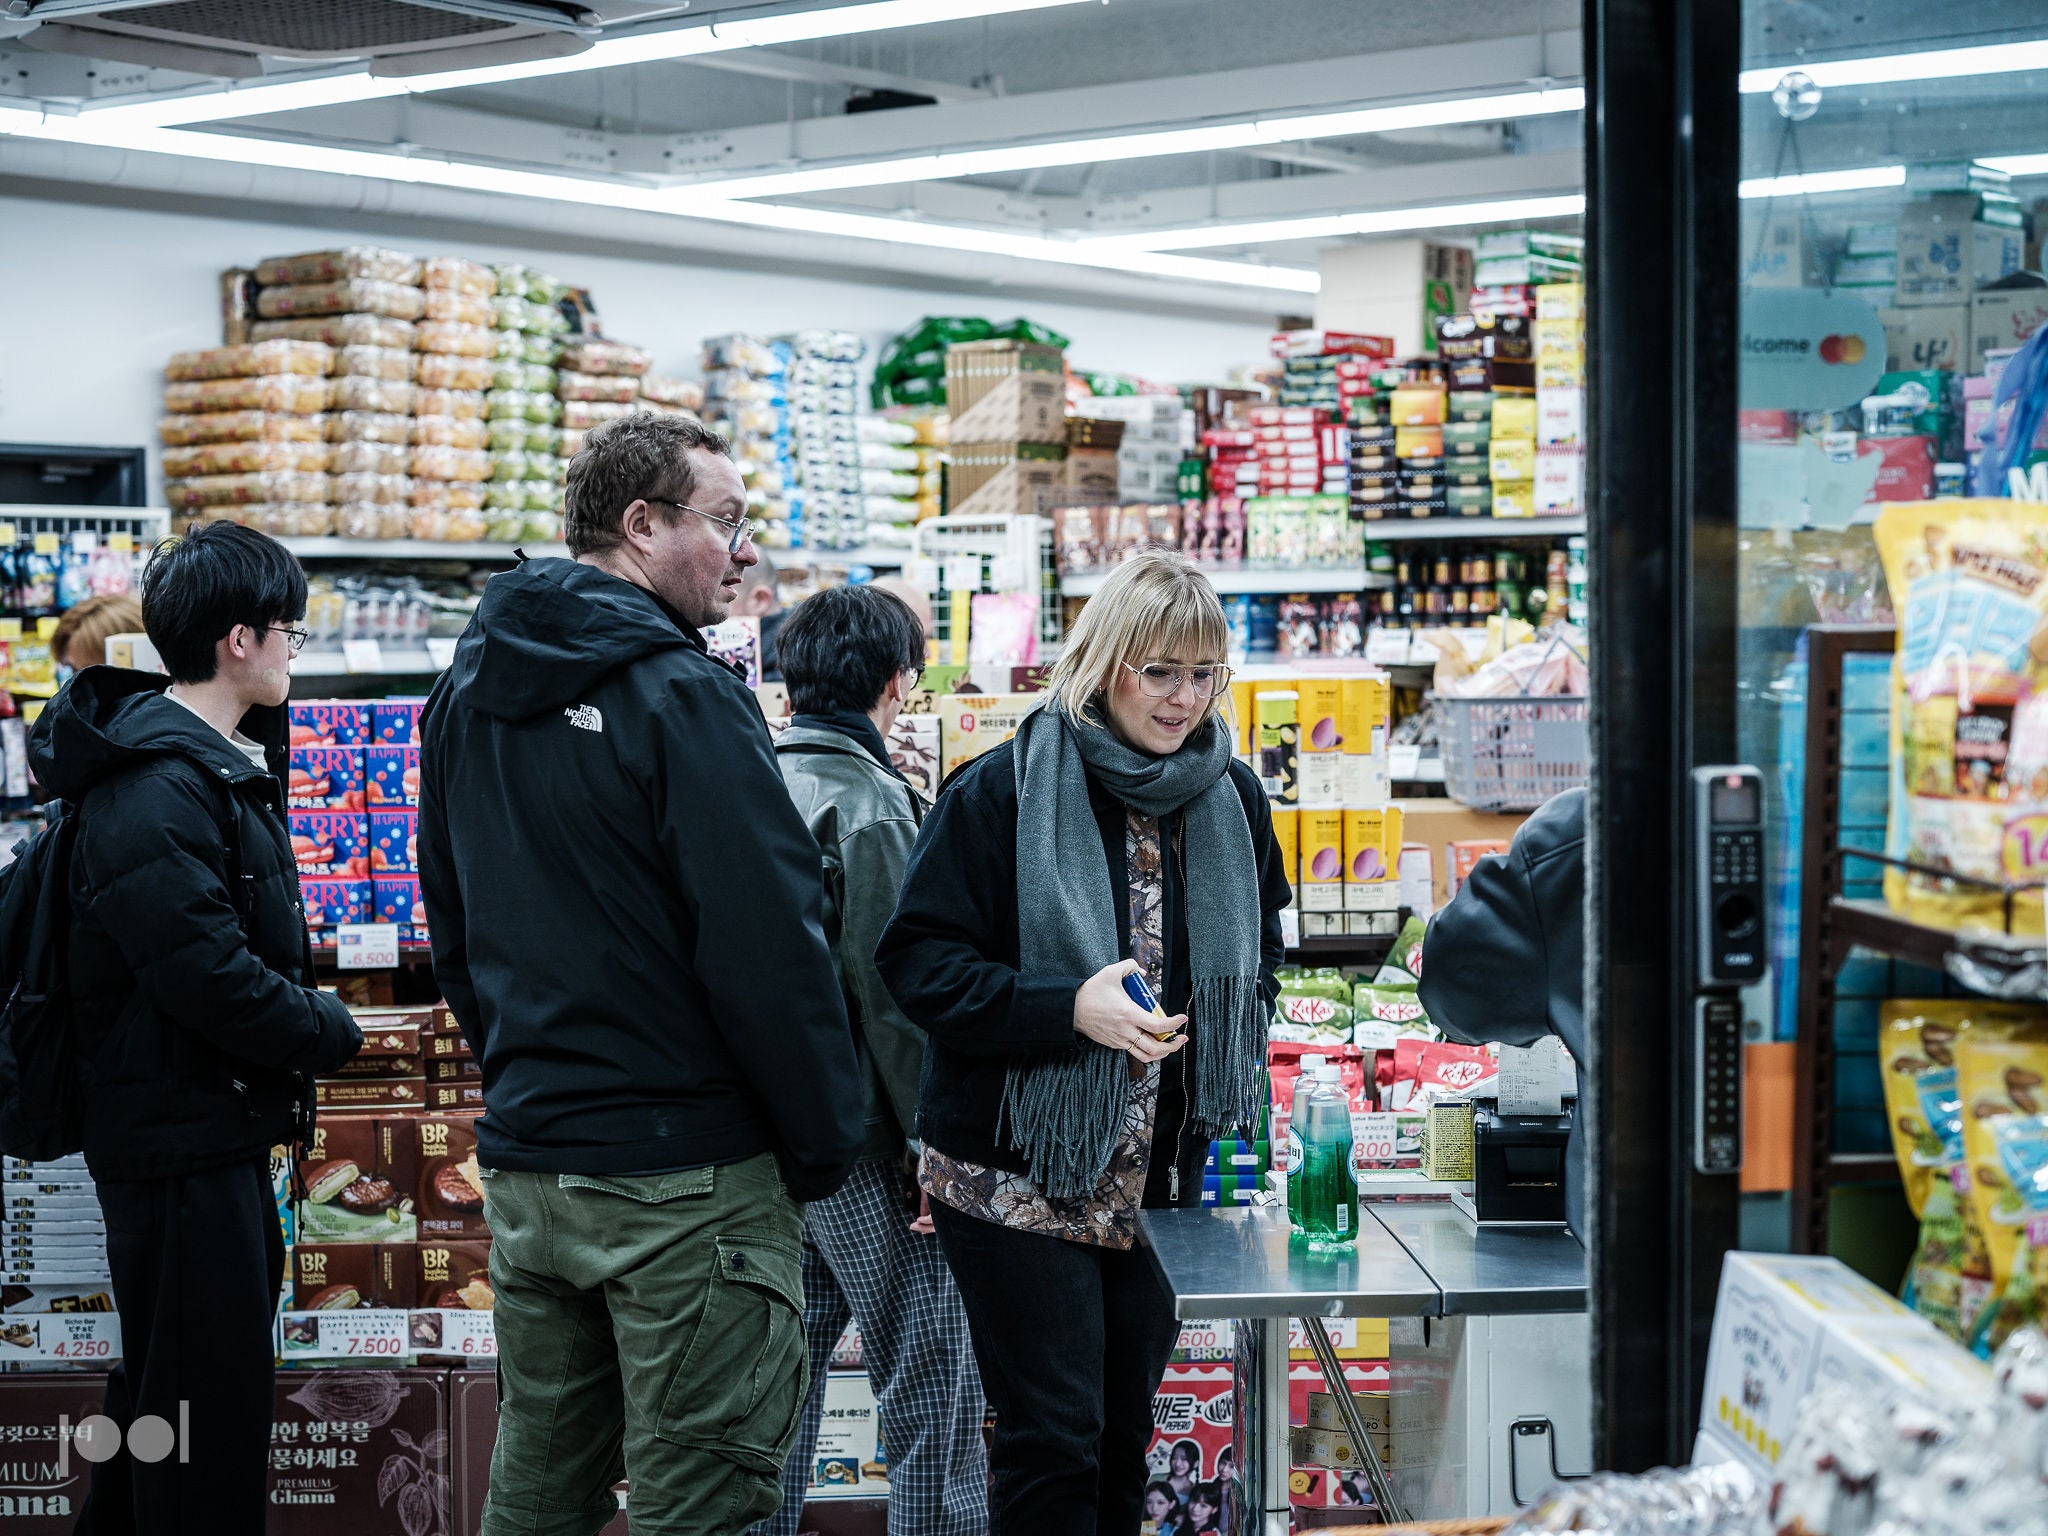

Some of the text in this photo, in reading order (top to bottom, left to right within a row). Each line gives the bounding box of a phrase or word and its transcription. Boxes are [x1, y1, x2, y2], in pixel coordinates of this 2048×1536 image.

[289, 705, 365, 729] ERRY
[564, 707, 591, 721] NORTH
[579, 703, 593, 714] THE
[570, 717, 590, 730] FACE
[353, 952, 395, 967] 6,500
[421, 1123, 449, 1144] BR
[1355, 1142, 1391, 1158] 800
[300, 1252, 327, 1272] BR
[422, 1248, 450, 1269] BR
[53, 1340, 110, 1358] 4,250
[462, 1336, 498, 1354] 6,5
[305, 1421, 371, 1443] 행복을
[276, 1478, 332, 1488] PREMIUM
[270, 1489, 336, 1504] Ghana
